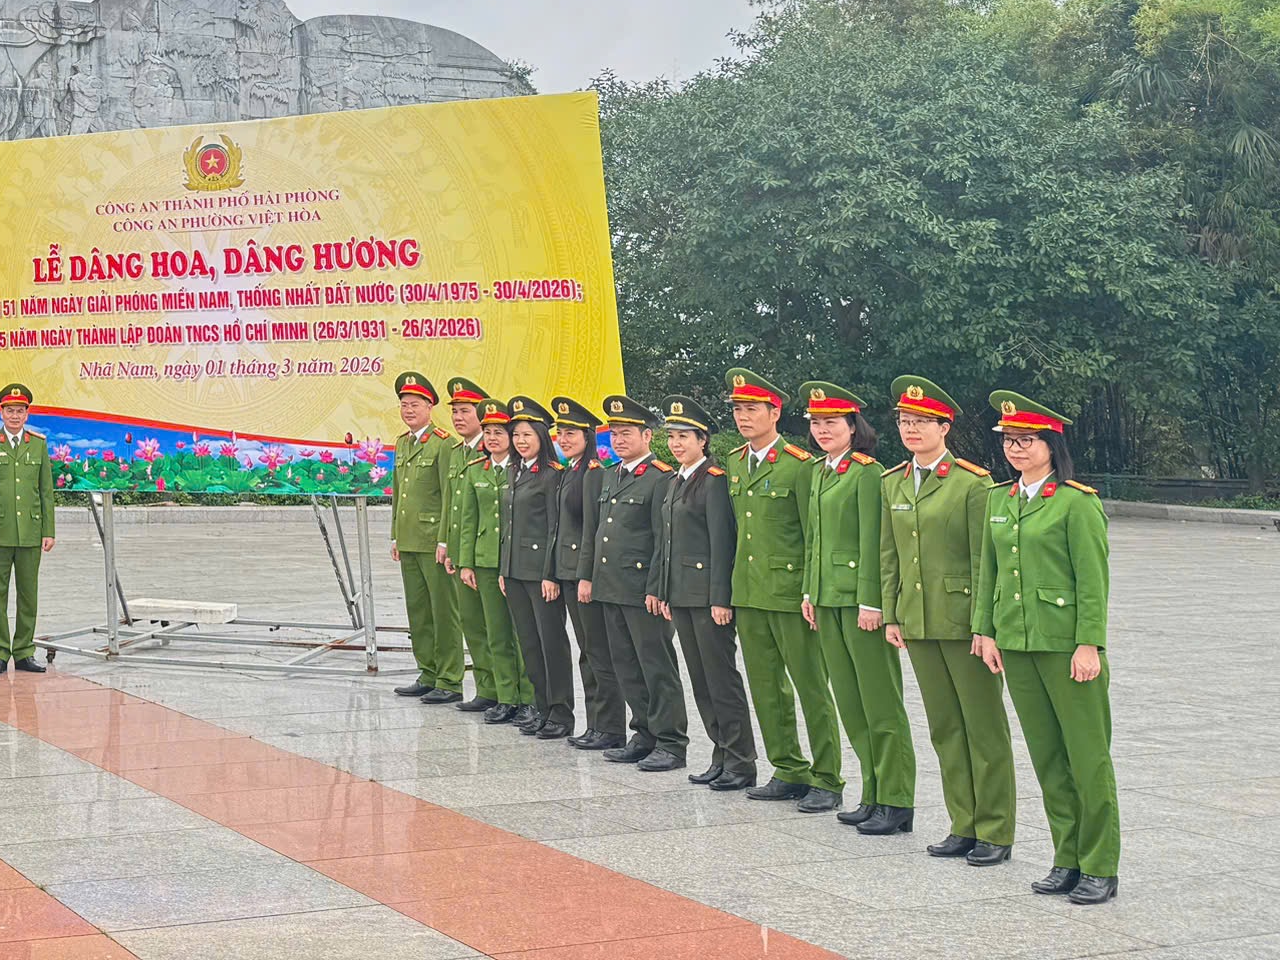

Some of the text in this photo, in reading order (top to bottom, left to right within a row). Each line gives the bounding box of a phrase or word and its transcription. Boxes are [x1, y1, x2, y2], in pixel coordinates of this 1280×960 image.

[95, 187, 340, 216] CÔNG AN THÀNH PHỐ HẢI PHÒNG
[113, 207, 321, 232] CÔNG AN PHƯỜNG VIỆT HÒA
[33, 236, 420, 282] LỄ DÂNG HOA, DÂNG HƯƠNG
[3, 300, 16, 316] 51
[20, 295, 48, 315] NĂM
[52, 293, 83, 314] NGÀY
[87, 290, 112, 312] GIẢI
[115, 290, 158, 311] PHÓNG
[161, 286, 195, 310] MIỀN
[199, 291, 234, 311] NAM,
[236, 283, 281, 307] THỐNG
[285, 281, 320, 306] NHẤT
[325, 280, 351, 304] ĐẤT
[355, 281, 395, 304] NƯỚC
[400, 282, 479, 305] (30/4/1975
[493, 279, 583, 301] 30/4/2026);
[10, 327, 38, 348] NĂM
[40, 325, 73, 347] NGÀY
[76, 324, 116, 345] THÀNH
[120, 323, 143, 348] LẬP
[147, 322, 182, 344] ĐOÀN
[185, 324, 219, 343] TNCS
[223, 318, 241, 342] HỒ
[245, 319, 269, 342] CHÍ
[272, 322, 309, 341] MINH
[313, 320, 386, 341] (26/3/1931
[401, 318, 481, 339] 26/3/2026)
[80, 356, 382, 379] Nhã Nam, ngày 01 tháng 3 năm 2026
